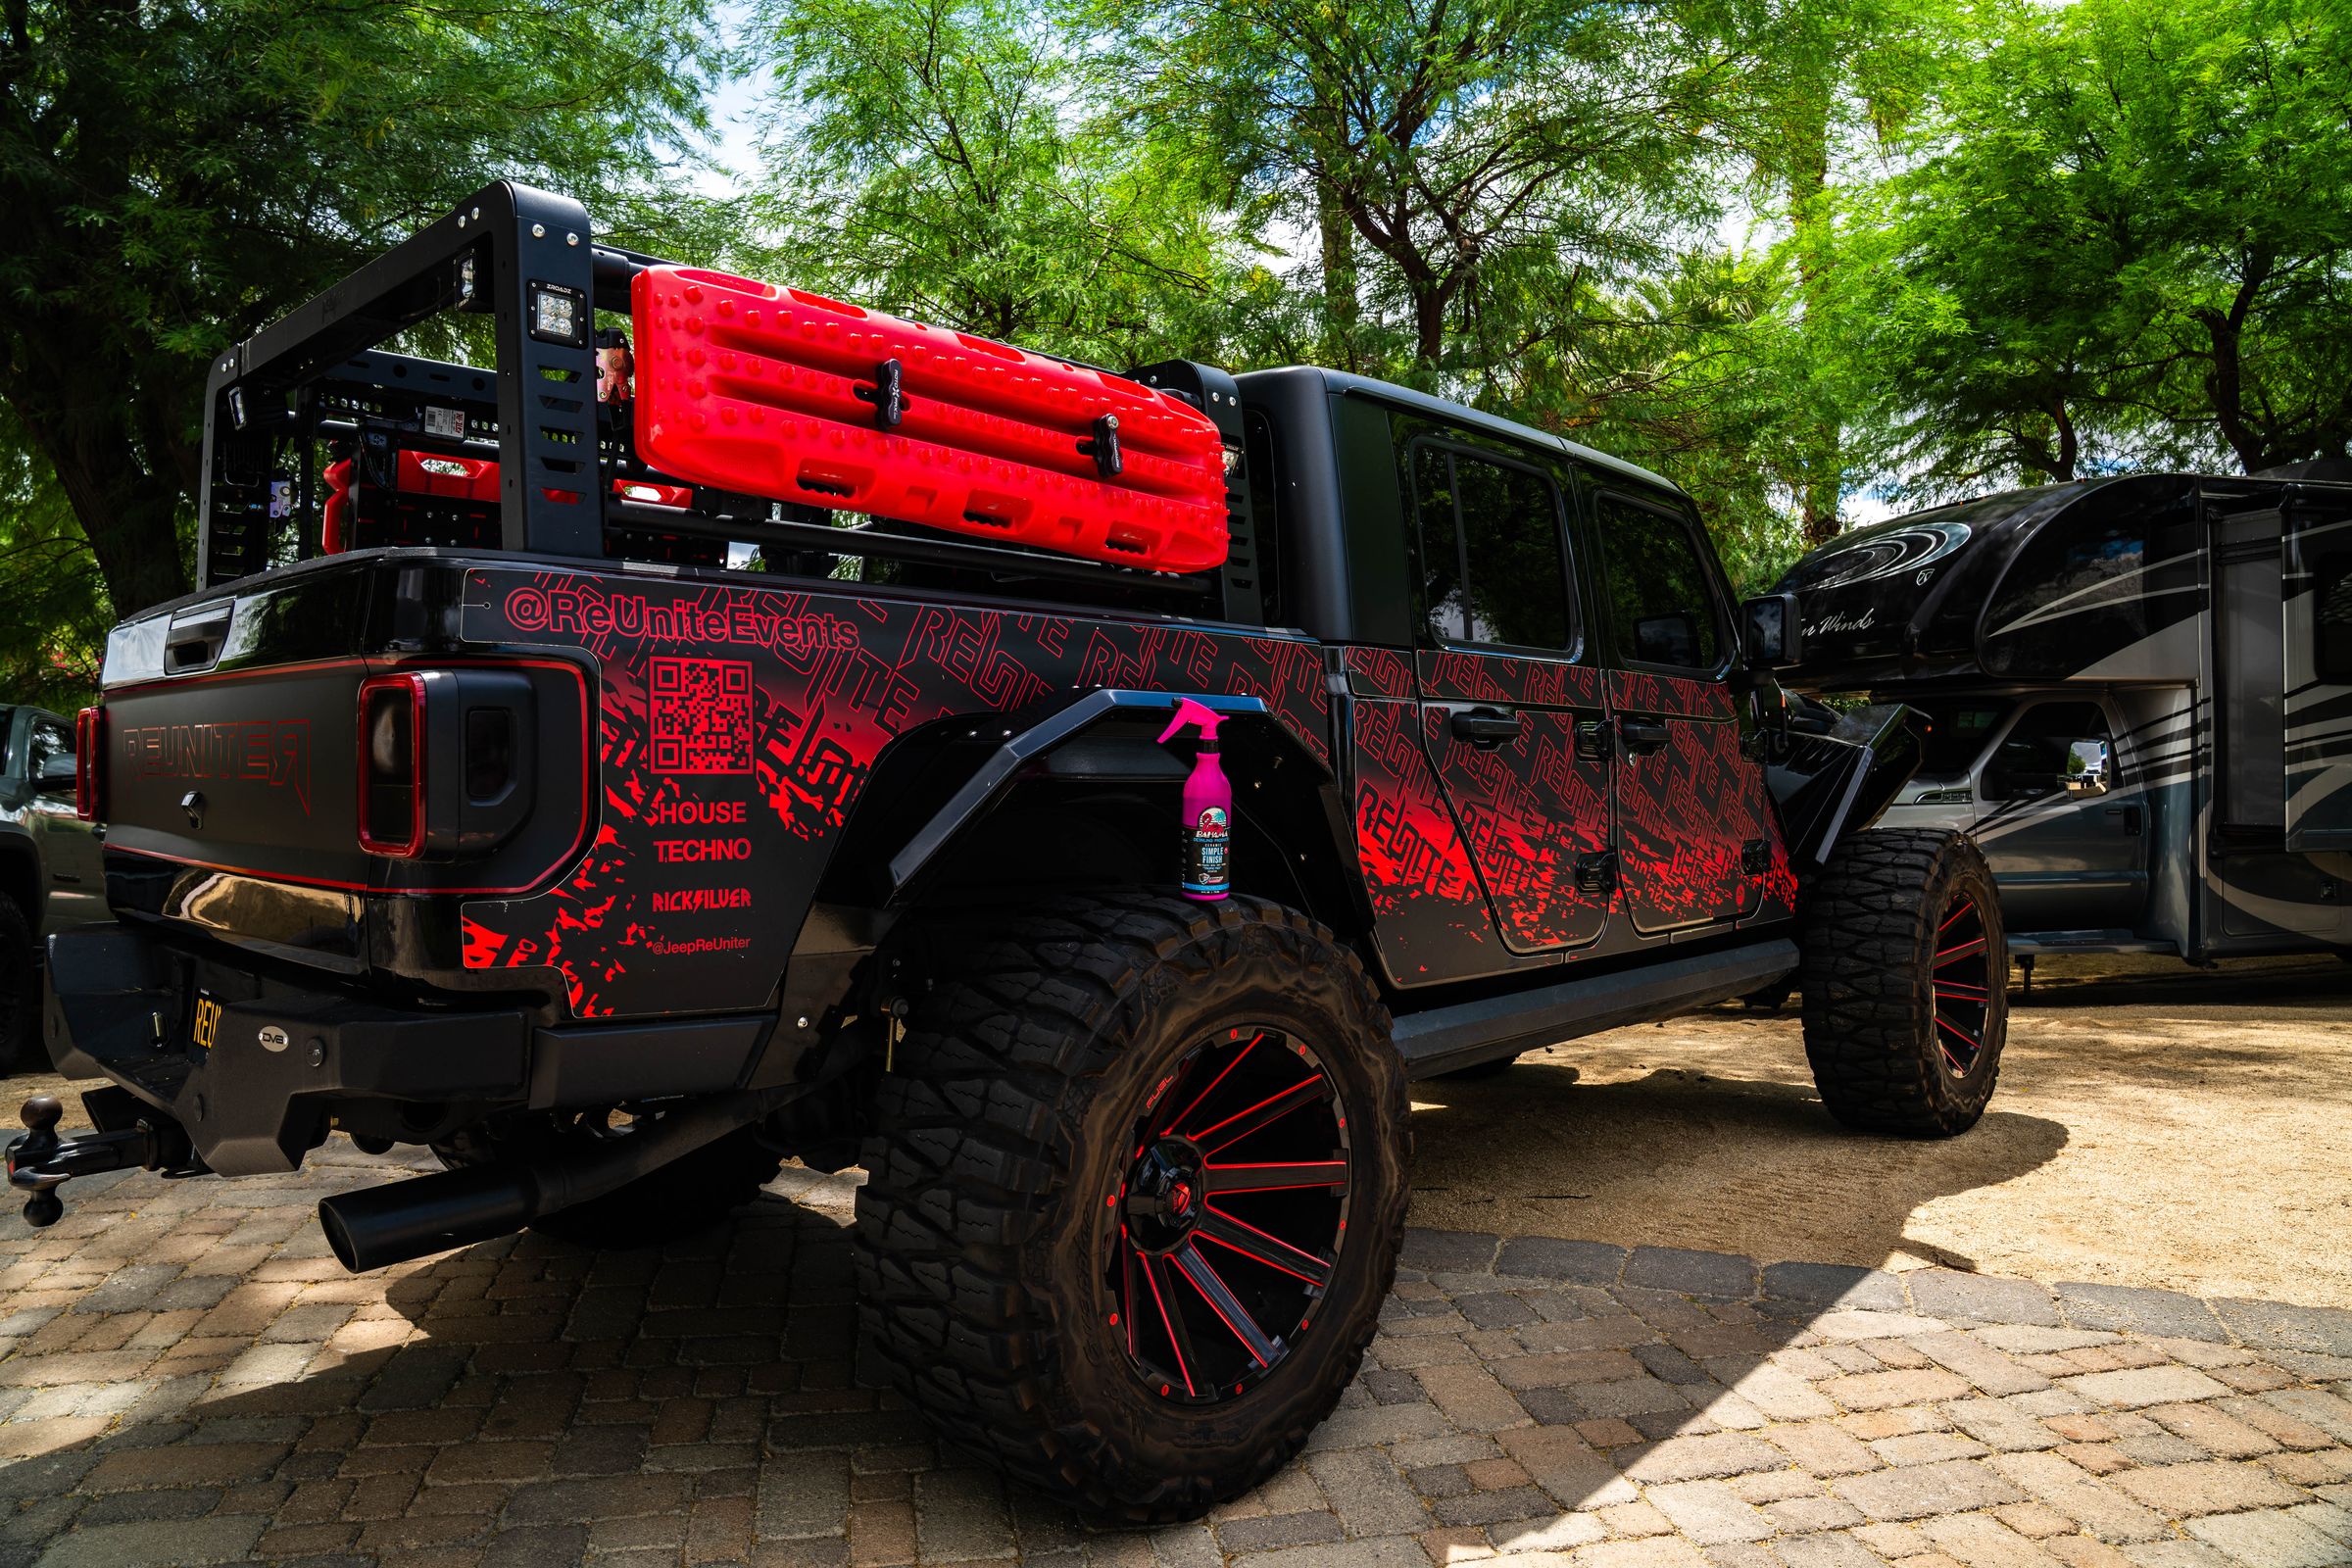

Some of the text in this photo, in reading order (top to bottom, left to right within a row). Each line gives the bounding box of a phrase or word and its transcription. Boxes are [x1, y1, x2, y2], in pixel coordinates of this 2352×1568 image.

[505, 587, 860, 651] @ReUniteEvents
[1819, 608, 1876, 635] Winds
[660, 801, 747, 824] HOUSE
[653, 838, 752, 862] TECHNO
[1201, 847, 1224, 856] SIMPLE
[1202, 855, 1223, 863] FINISH
[652, 936, 752, 956] @JeepReUniter
[1146, 1075, 1174, 1109] FUEL
